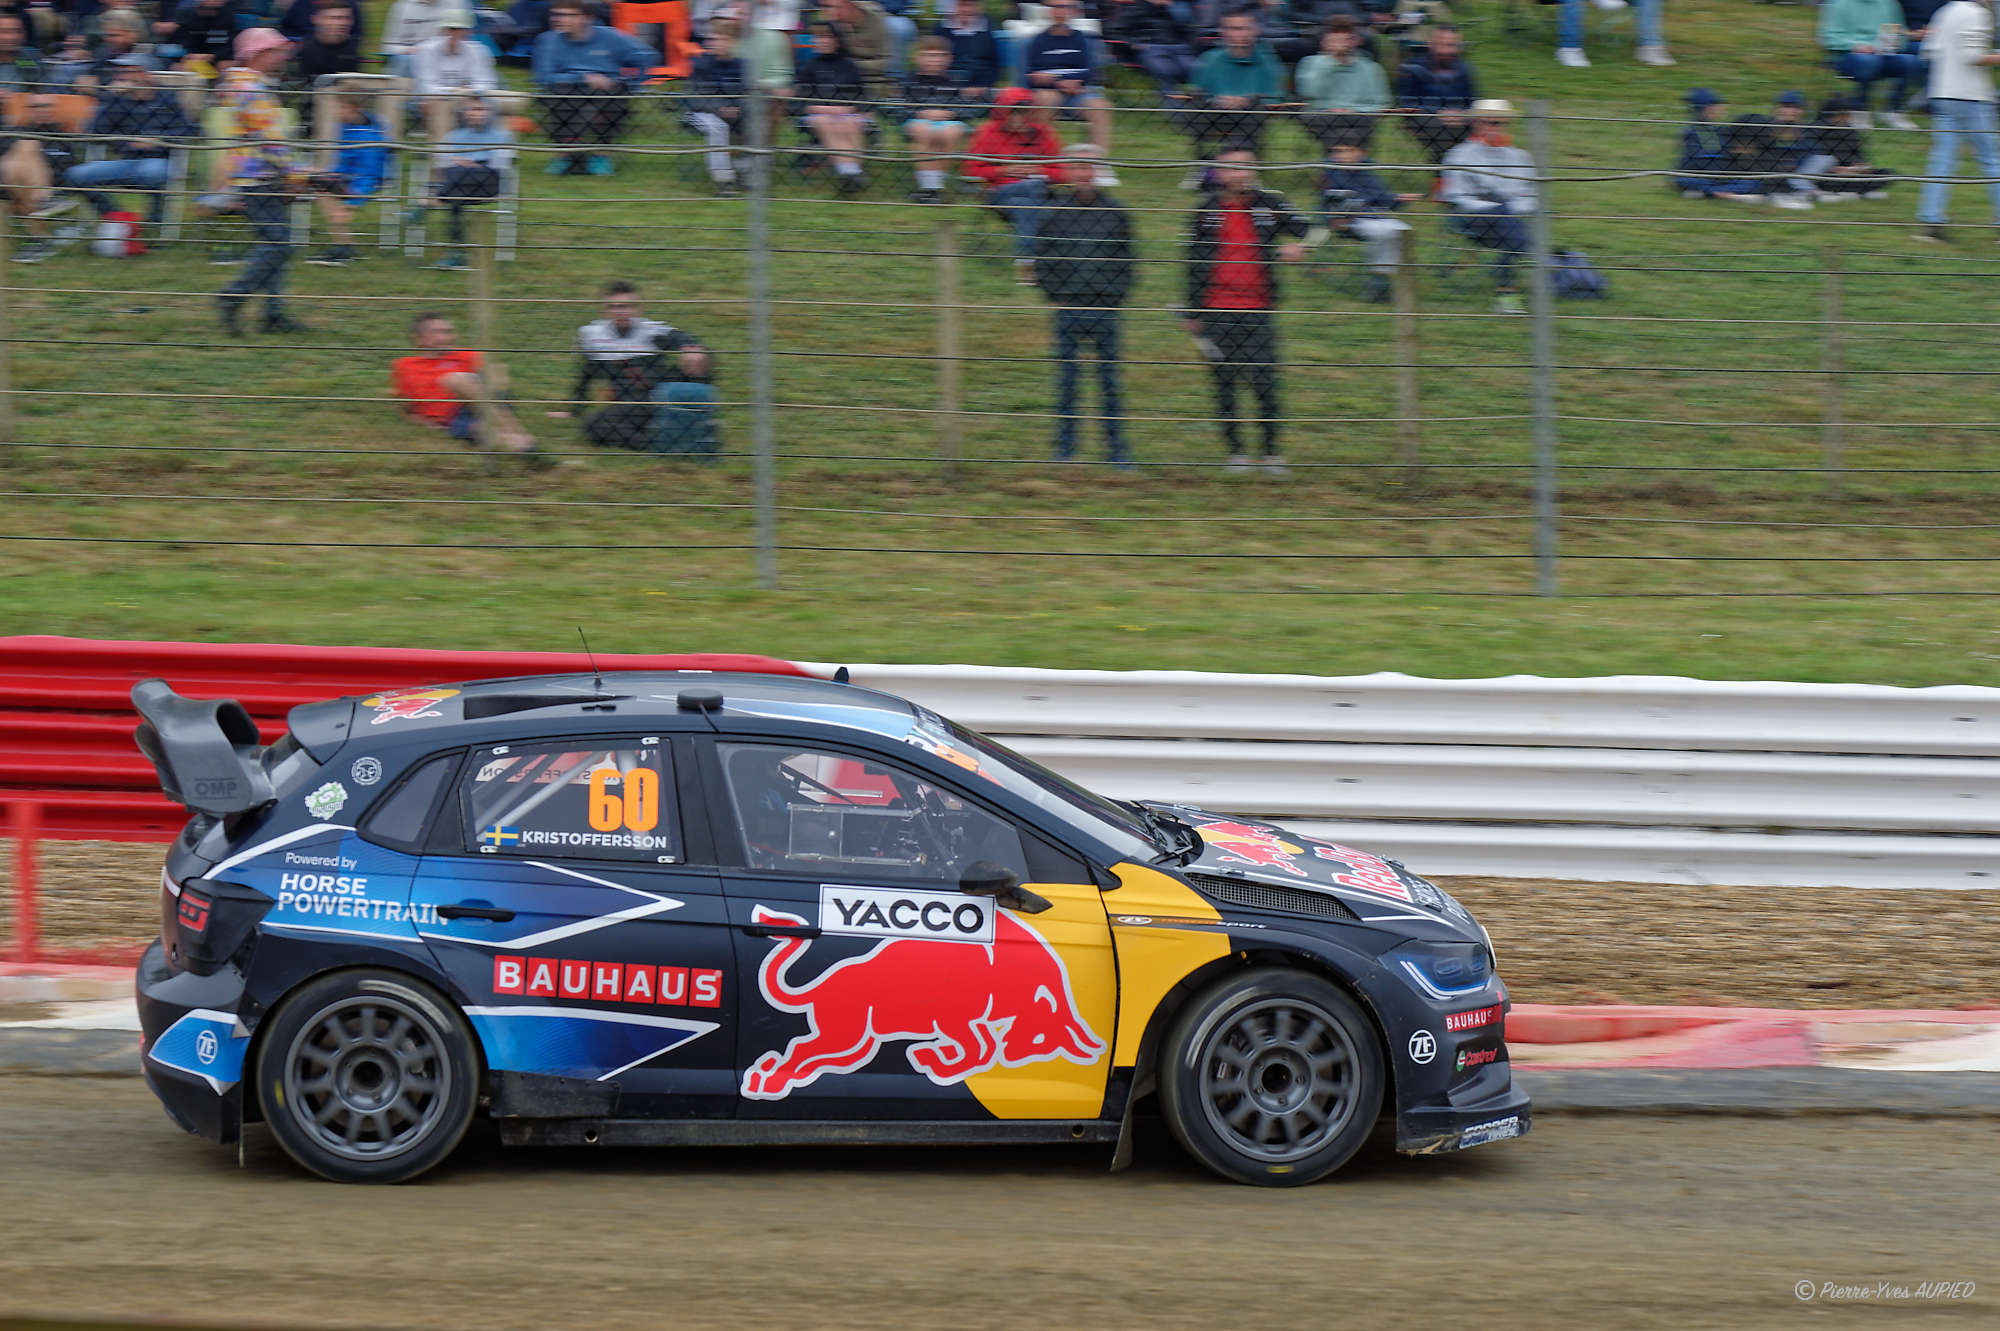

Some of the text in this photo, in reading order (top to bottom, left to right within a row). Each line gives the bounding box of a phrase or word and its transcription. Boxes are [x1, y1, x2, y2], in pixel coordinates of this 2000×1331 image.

[195, 782, 237, 797] OMP
[588, 767, 660, 832] 60
[522, 830, 667, 849] KRISTOFFERSSON
[285, 852, 358, 871] Powered by
[280, 873, 368, 896] HORSE
[832, 898, 984, 934] YACCO
[498, 961, 718, 1002] BAUHAUS
[1410, 1034, 1435, 1059] ZF
